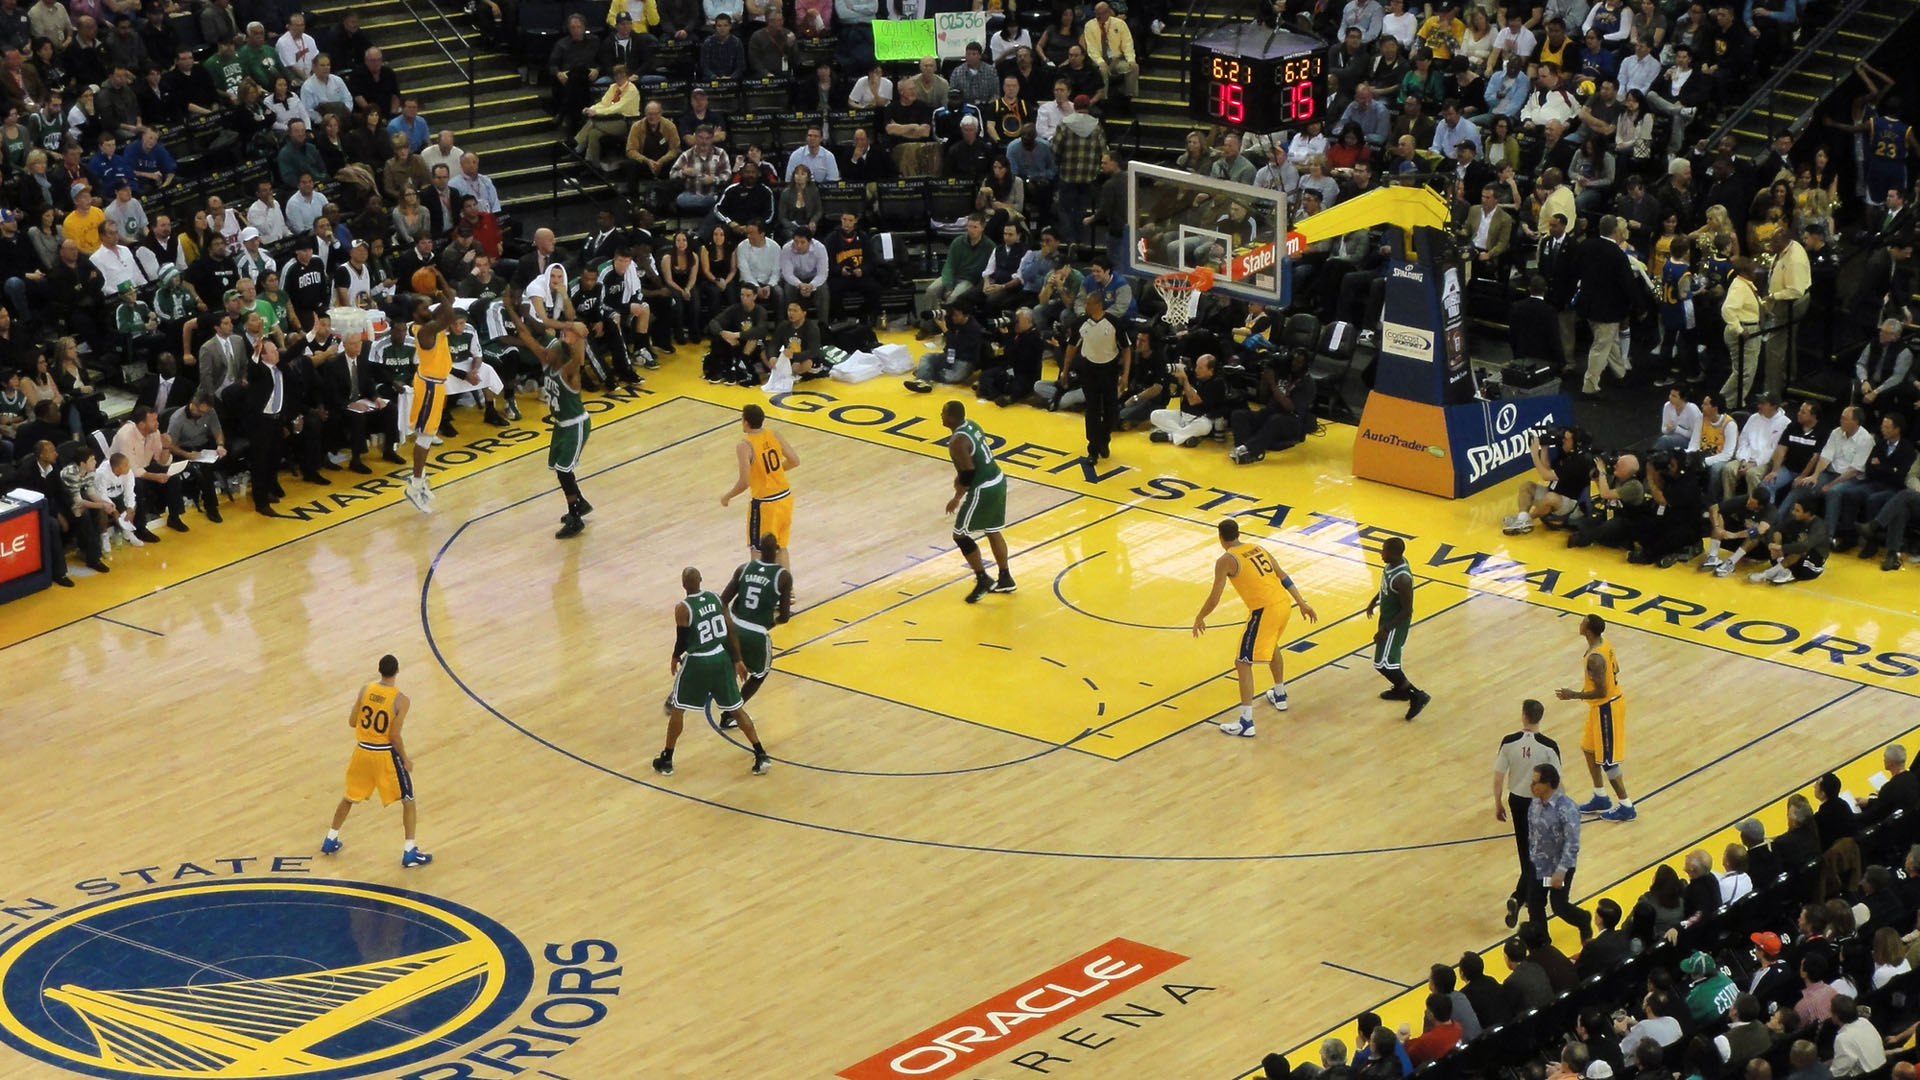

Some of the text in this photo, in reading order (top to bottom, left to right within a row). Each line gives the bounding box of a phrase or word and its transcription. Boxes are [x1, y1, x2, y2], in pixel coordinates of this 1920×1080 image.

[940, 13, 984, 30] 02536
[1213, 58, 1251, 84] 6:21
[1285, 58, 1320, 83] 6:21
[1220, 84, 1243, 121] 15
[1292, 81, 1314, 119] 15
[1875, 140, 1897, 159] 23
[1243, 250, 1271, 276] State
[1393, 267, 1423, 283] SPALDING
[1362, 429, 1428, 453] AutoTrader
[762, 448, 780, 475] 10
[1129, 477, 1418, 555] STATE
[1427, 543, 1920, 678] WARRIORS
[1250, 553, 1273, 577] 15
[744, 574, 771, 587] GARNETT
[698, 603, 717, 617] ALLEN
[744, 586, 762, 610] 5
[697, 614, 728, 645] 20
[360, 705, 389, 734] 30
[1522, 746, 1532, 759] 14
[75, 856, 313, 896] STATE
[890, 955, 1143, 1074] ORACLE
[1000, 982, 1216, 1077] RENA
